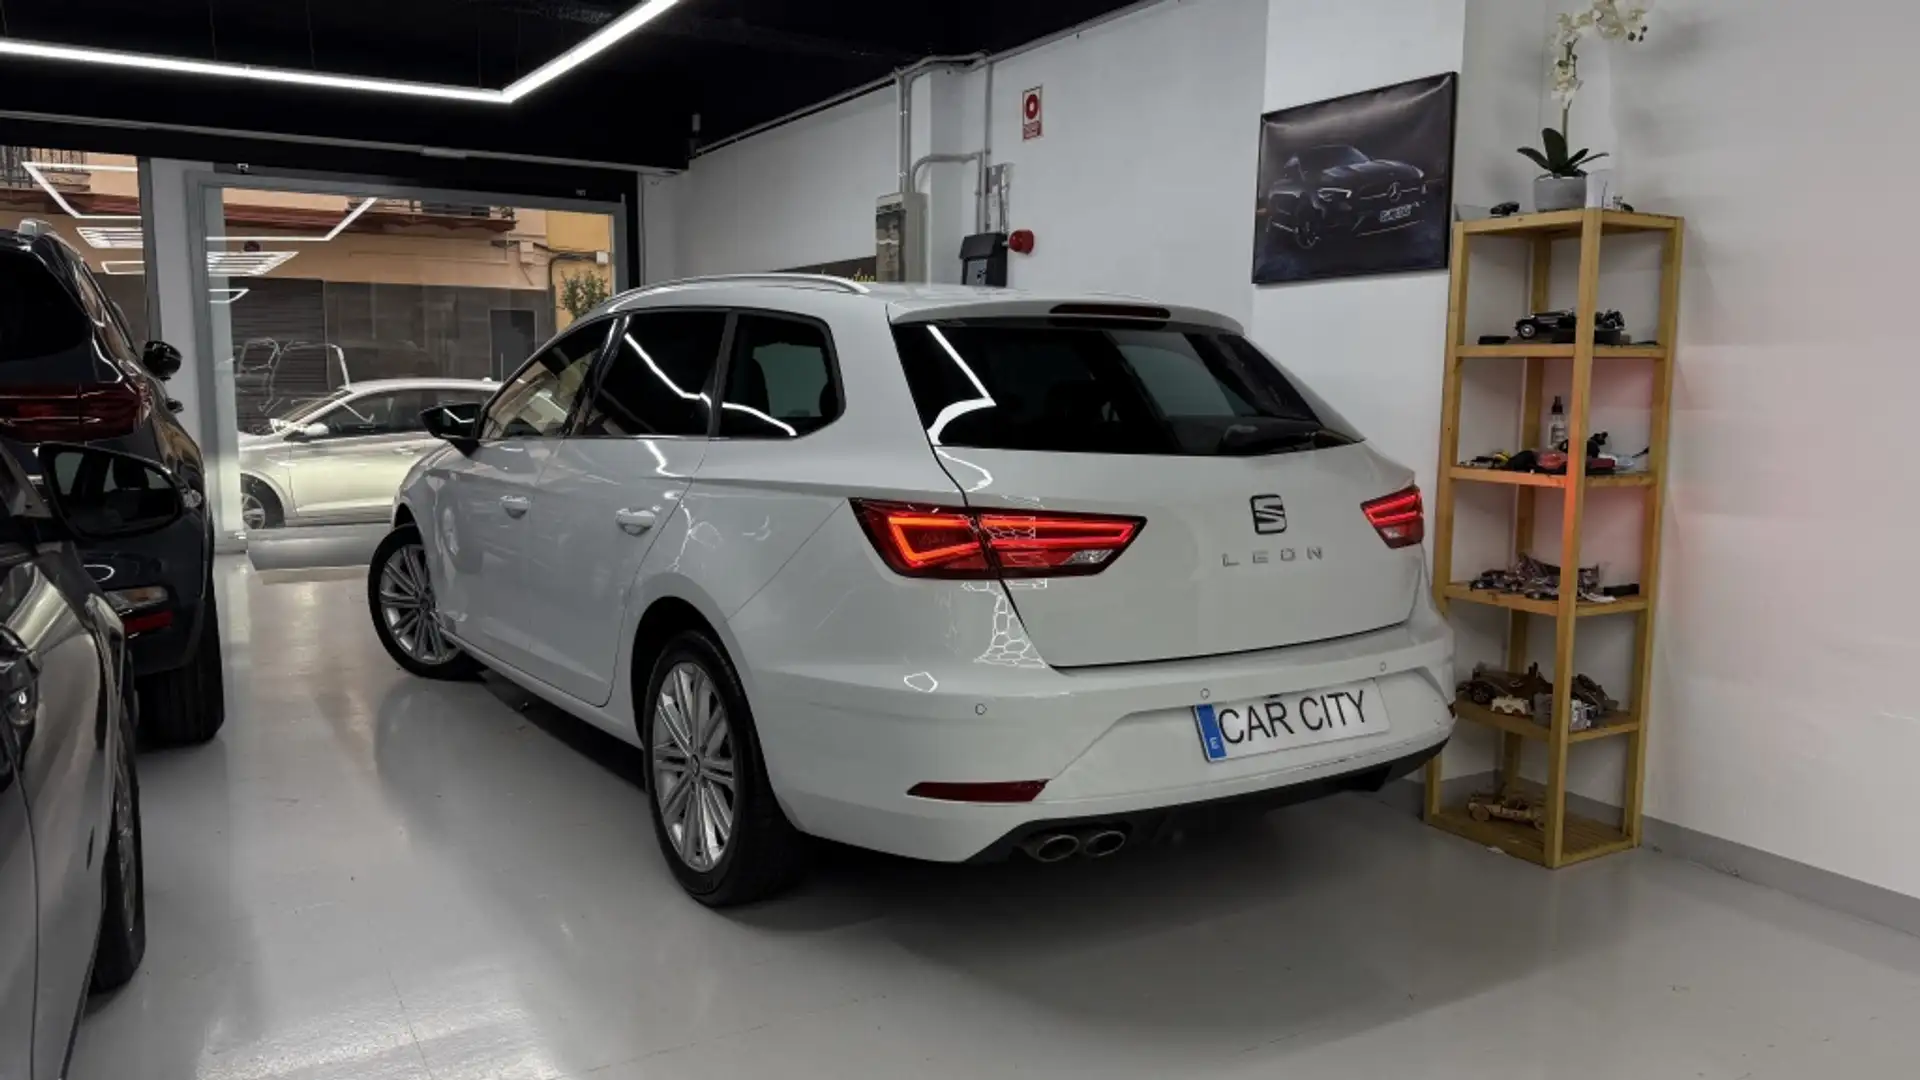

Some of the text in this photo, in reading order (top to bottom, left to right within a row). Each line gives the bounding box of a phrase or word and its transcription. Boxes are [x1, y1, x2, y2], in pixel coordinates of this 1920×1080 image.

[1222, 547, 1323, 567] LEON
[1219, 690, 1365, 744] CAR CITY
[1209, 737, 1220, 749] E
